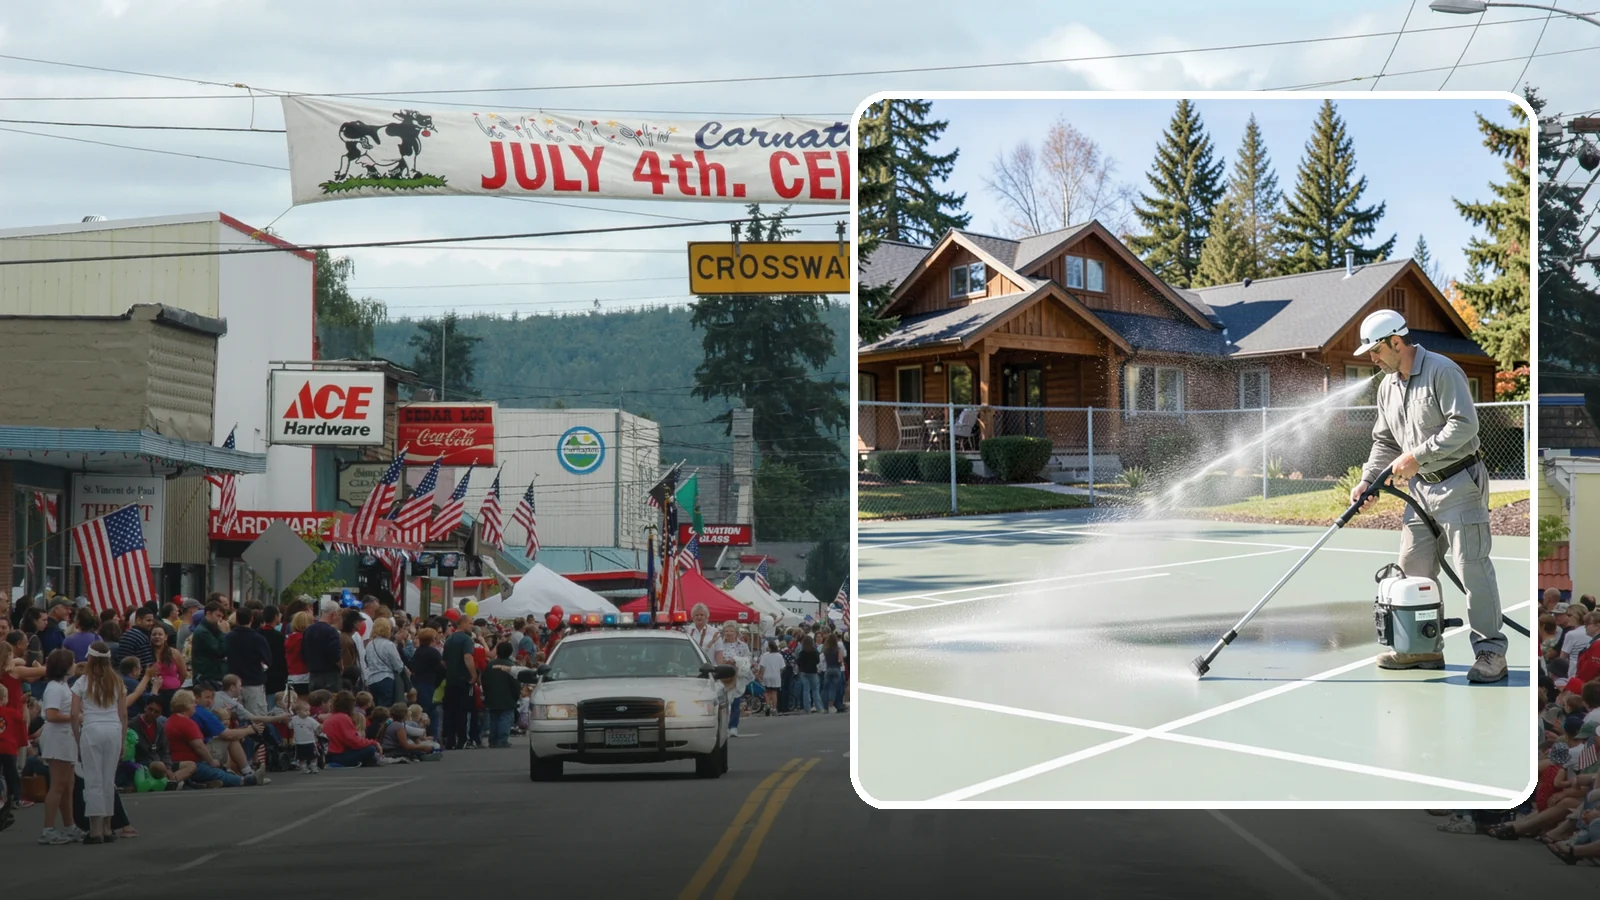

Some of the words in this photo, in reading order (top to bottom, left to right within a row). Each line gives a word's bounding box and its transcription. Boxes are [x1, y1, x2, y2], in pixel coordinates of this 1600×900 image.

[695, 121, 850, 150] Carnat
[481, 141, 604, 193] JULY
[632, 150, 746, 198] 4th.
[697, 254, 850, 280] CROSSWA
[283, 380, 373, 420] ACE
[406, 410, 452, 421] CEDAR
[283, 421, 371, 436] Hardware
[416, 428, 477, 447] Coca-Cola
[353, 467, 385, 479] Simpl
[83, 484, 93, 494] St.
[96, 485, 124, 494] Vincent
[126, 486, 136, 494] de
[137, 486, 155, 495] Paul
[688, 526, 741, 535] CRNATION
[699, 535, 730, 543] GLASS
